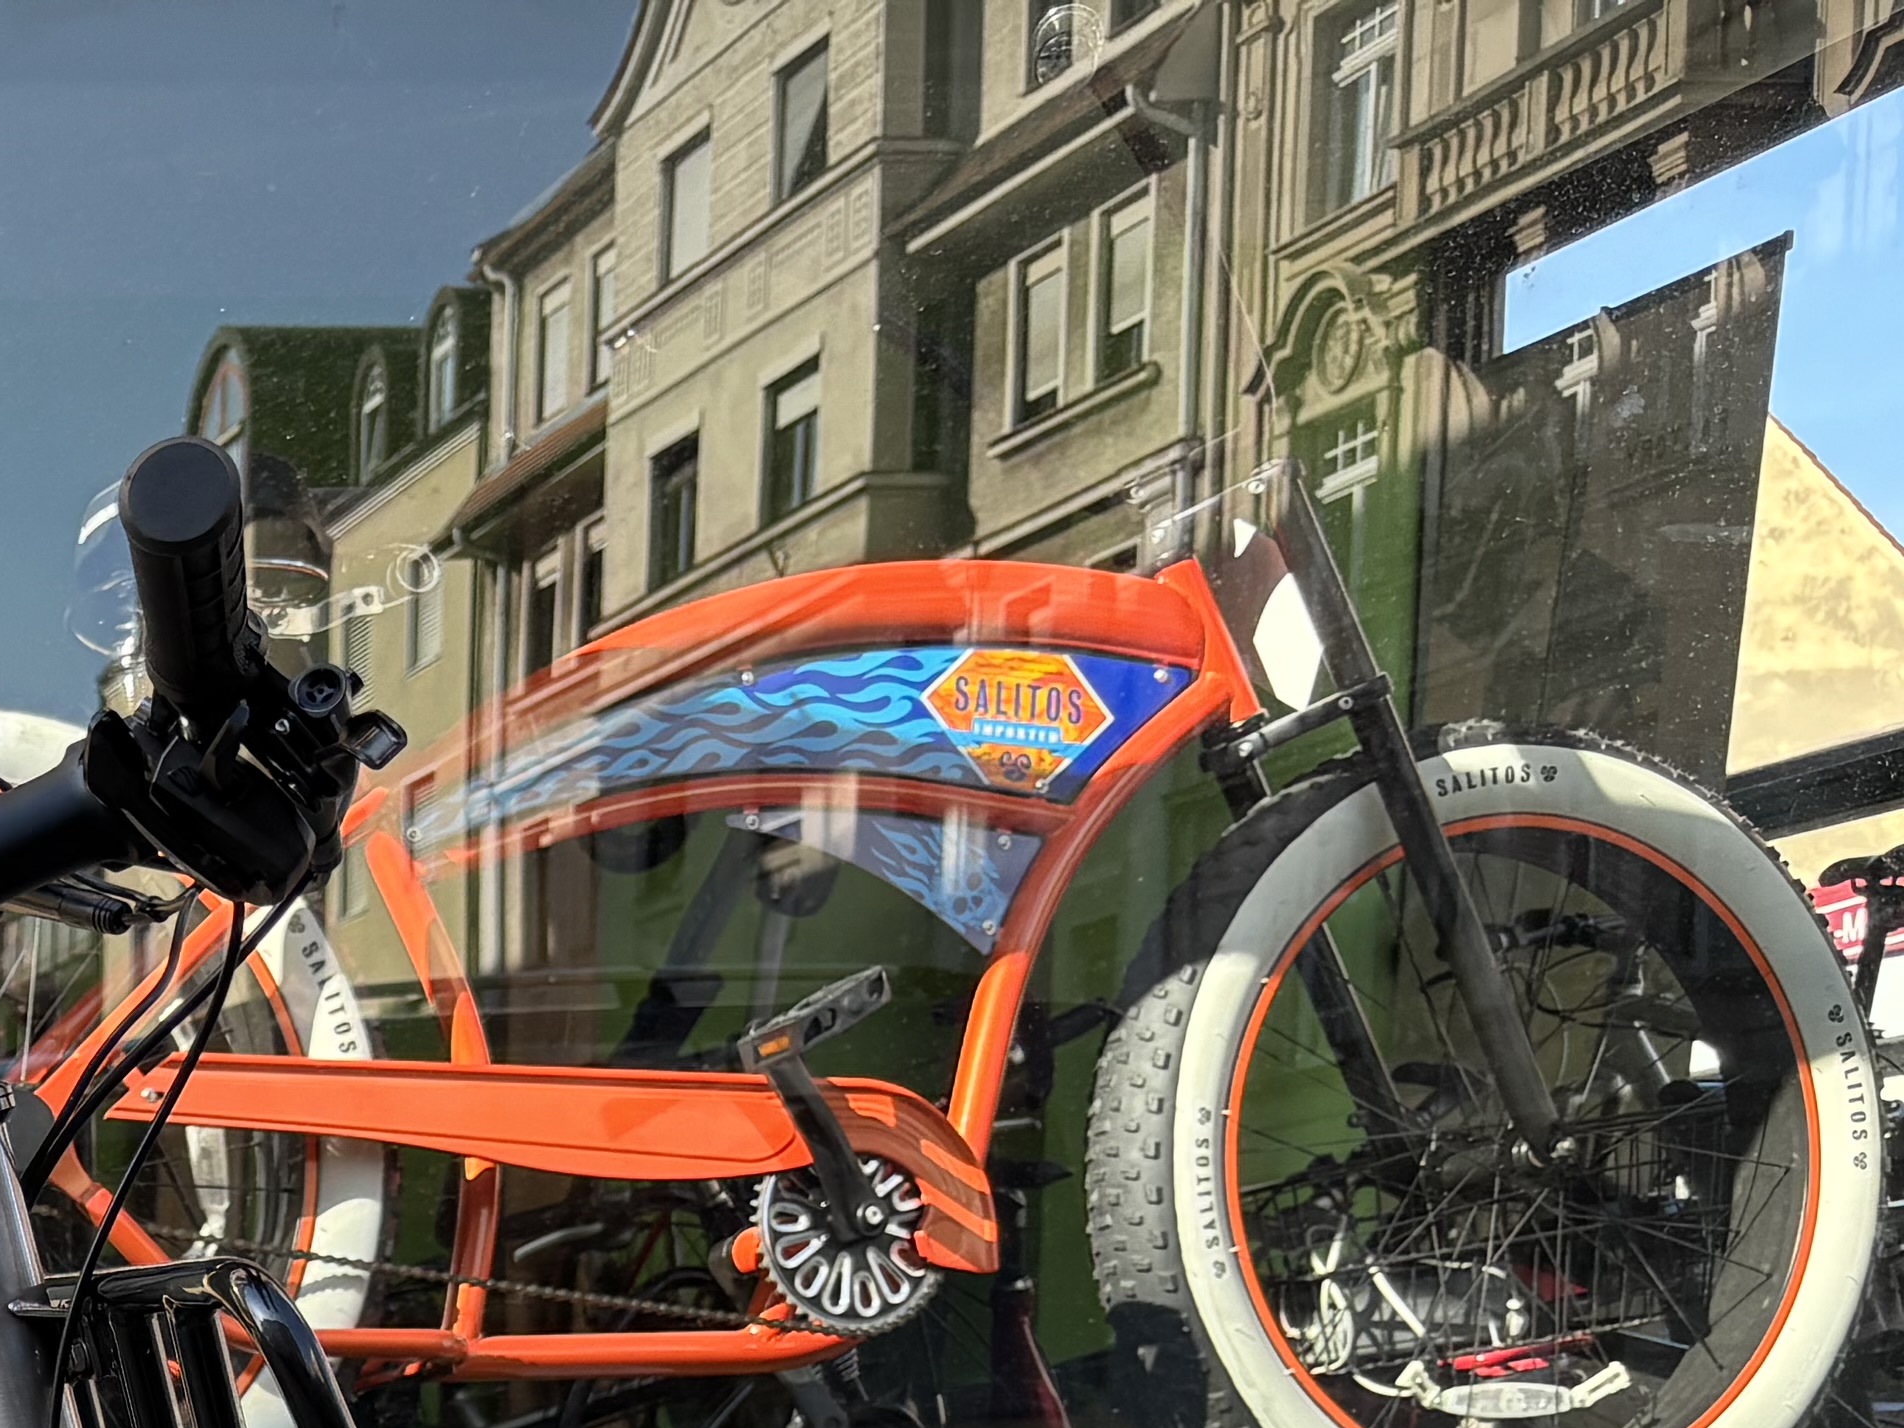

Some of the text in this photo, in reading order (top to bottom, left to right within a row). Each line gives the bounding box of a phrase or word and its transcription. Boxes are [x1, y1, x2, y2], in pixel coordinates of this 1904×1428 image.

[954, 675, 1081, 725] SALITOS
[973, 721, 1060, 744] IMPORTED
[1436, 764, 1532, 797] SALITOS
[302, 941, 357, 1055] SALITOS
[1835, 1031, 1868, 1142] SALITOS
[1195, 1138, 1220, 1250] SALITOS
